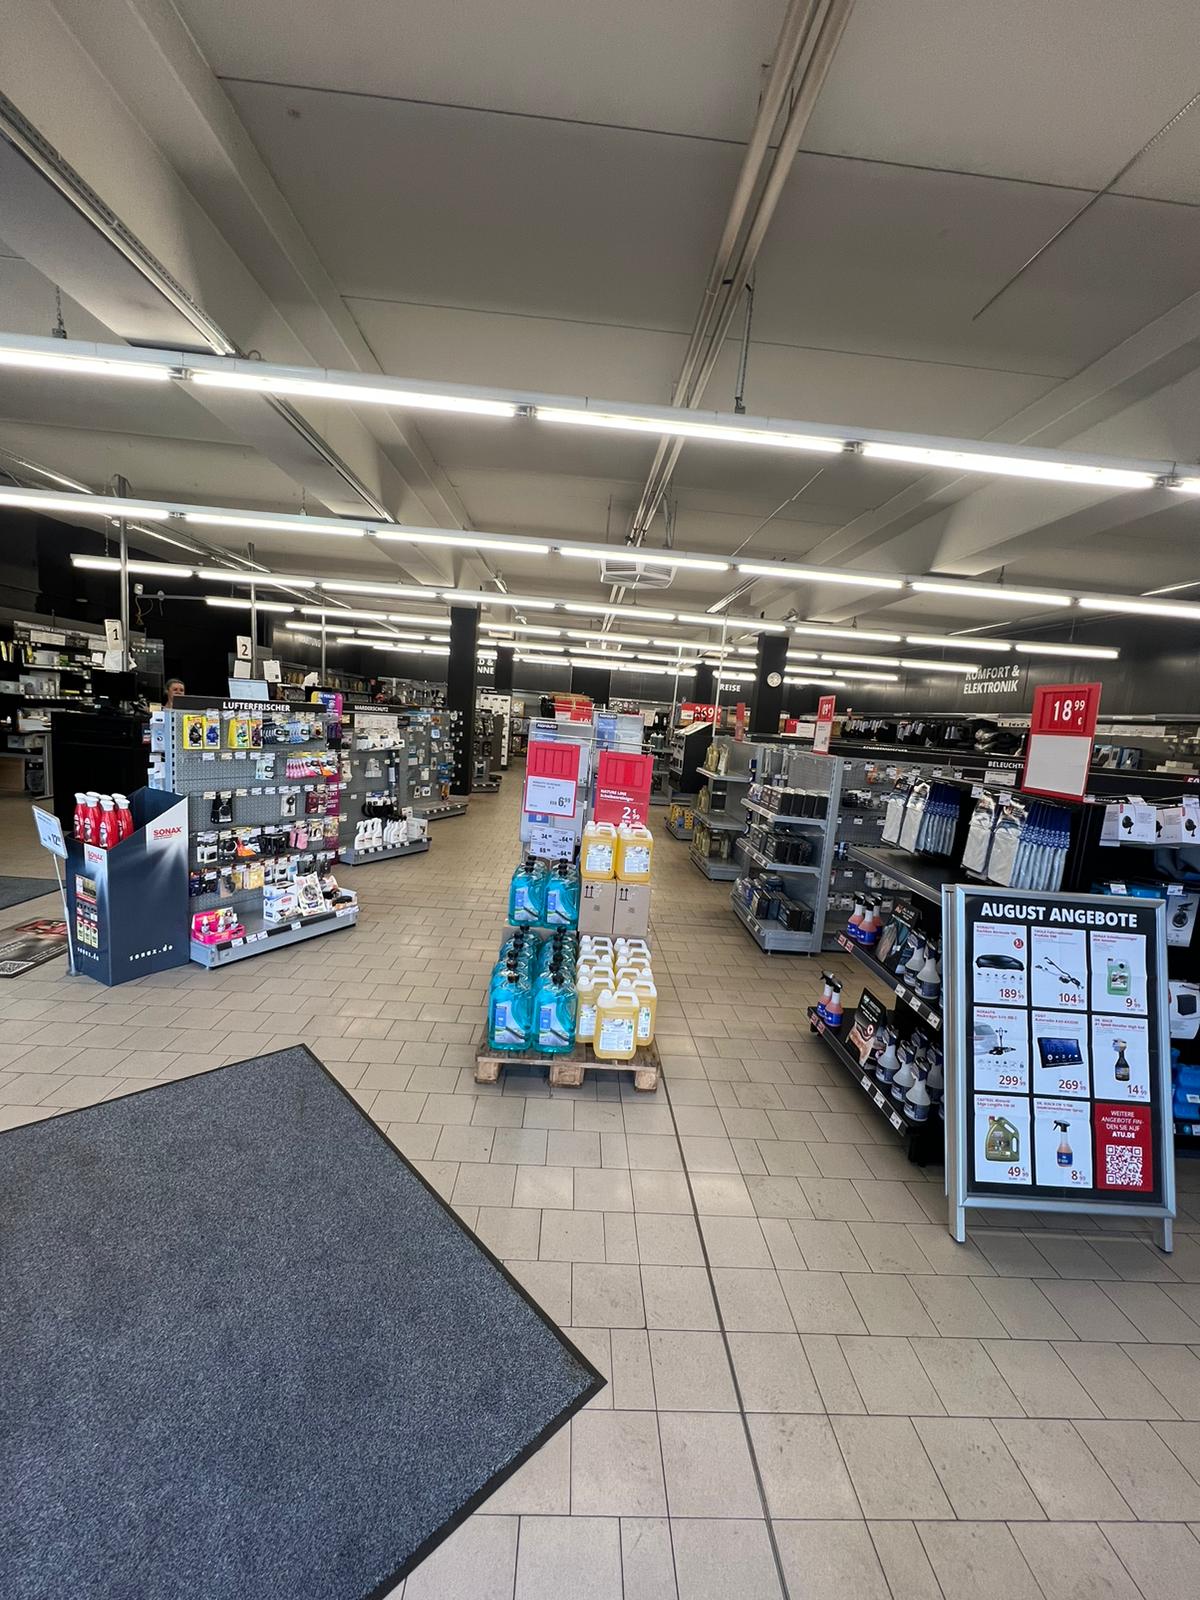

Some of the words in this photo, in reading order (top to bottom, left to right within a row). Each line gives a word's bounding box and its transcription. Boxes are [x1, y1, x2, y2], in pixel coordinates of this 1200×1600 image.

[112, 628, 119, 641] 1
[242, 644, 249, 656] 2
[1011, 664, 1020, 677] &
[719, 683, 741, 693] REISE
[963, 679, 1019, 695] ELEKTRONIK
[222, 700, 291, 712] LUFTERFRISCHER
[1054, 699, 1073, 722] 18
[621, 806, 632, 820] 2
[153, 826, 182, 837] SONAX
[981, 902, 1046, 921] AUGUST
[1049, 907, 1138, 929] ANGEBOTE
[128, 944, 173, 962] sonax.de
[999, 988, 1017, 999] 189
[1059, 992, 1077, 1004] 104
[999, 1074, 1019, 1087] 299
[1058, 1079, 1079, 1091] 269
[1127, 1083, 1140, 1096] 14
[1101, 1116, 1132, 1124] ANGEBOTE
[1110, 1110, 1135, 1118] WEITERE
[1128, 1124, 1140, 1132] AUF
[1111, 1131, 1136, 1139] ATU.DE
[1007, 1166, 1021, 1177] 49
[1071, 1169, 1078, 1182] 8
